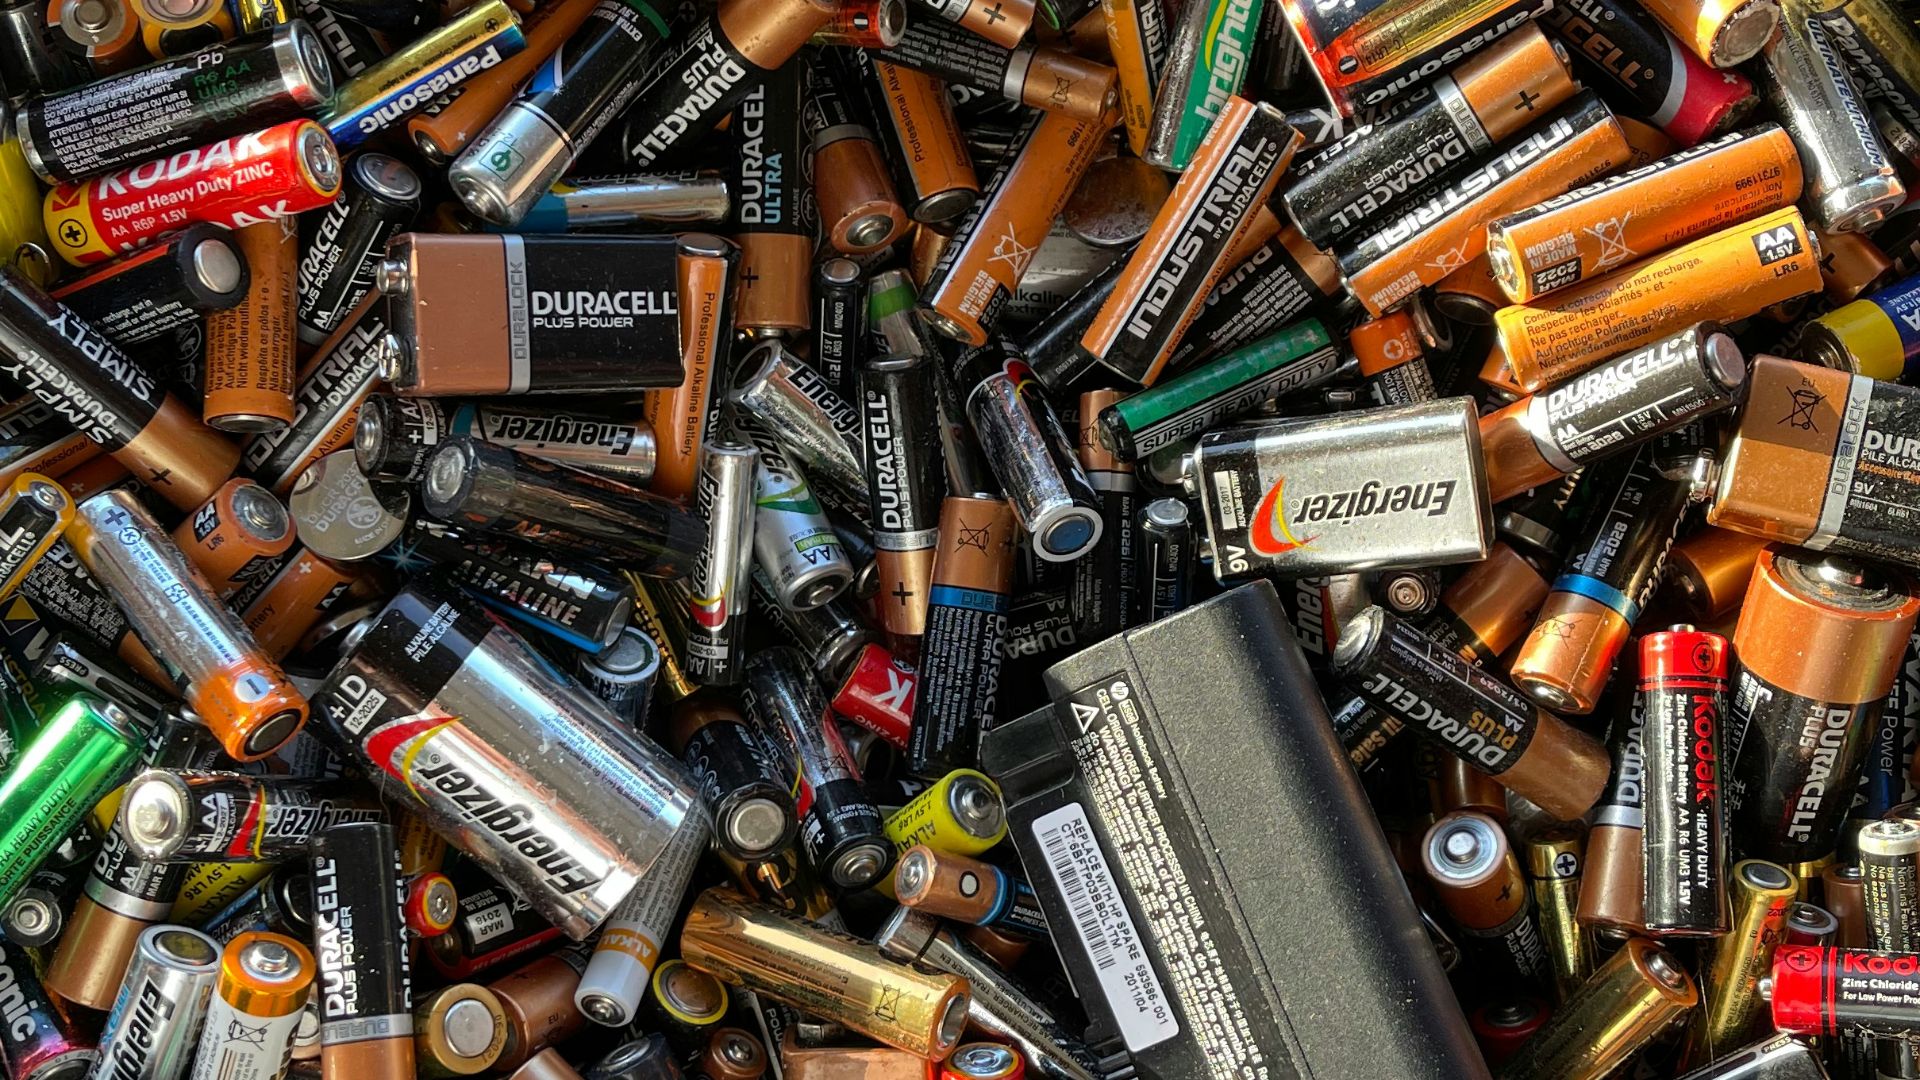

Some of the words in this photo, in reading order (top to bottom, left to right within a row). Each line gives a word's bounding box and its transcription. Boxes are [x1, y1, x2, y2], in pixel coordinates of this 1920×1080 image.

[197, 51, 224, 69] Pb
[682, 42, 728, 90] PLUS
[1366, 0, 1555, 105] Panasonic
[358, 43, 504, 134] Panasonic
[1805, 18, 1850, 98] ULTIMATE
[1841, 98, 1884, 166] LITHIUM
[63, 111, 86, 121] MAKE
[112, 102, 151, 120] EXPLOSER
[631, 57, 747, 162] DURACELL
[892, 80, 926, 163] Professional
[740, 84, 765, 225] DURACEL
[1415, 127, 1456, 159] PLUS
[98, 128, 277, 200] KODAK
[1362, 152, 1416, 191] POWER
[1735, 166, 1780, 190] 97311999
[102, 202, 149, 223] Super
[147, 186, 197, 210] Heavy
[196, 173, 234, 200] Duty
[234, 161, 275, 185] ZINC
[764, 152, 783, 224] ULTRA
[1217, 148, 1278, 232] DURACELL
[1330, 138, 1468, 230] DURACELL
[1357, 117, 1576, 251] INDUSTRIAL
[110, 225, 130, 239] AA
[132, 217, 156, 233] R6P
[161, 208, 189, 225] 1.5V
[1127, 136, 1268, 340] INDUSTRIAL
[1212, 229, 1223, 240] BY
[1758, 226, 1795, 251] AA
[298, 201, 350, 295] URACELL
[1524, 232, 1576, 259] BELGIUM
[1766, 242, 1794, 261] 1.5V
[300, 289, 320, 319] PLUS
[316, 244, 343, 288] POWER
[1536, 260, 1579, 284] 2022
[1538, 273, 1576, 293] MAR
[1774, 261, 1799, 277] LR6
[531, 290, 678, 316] DURACELL
[958, 270, 985, 314] BELGIUM
[979, 276, 997, 304] MADE
[1523, 304, 1565, 325] Connect
[1634, 273, 1651, 286] not
[1653, 257, 1703, 280] recharge.
[313, 309, 331, 329] AA
[533, 316, 574, 328] PLUS
[579, 316, 634, 328] POWER
[696, 292, 716, 365] Professional
[967, 304, 979, 318] IN
[1526, 312, 1582, 336] Respecter
[1599, 289, 1643, 315] polarités
[1549, 331, 1568, 346] pas
[1569, 309, 1627, 338] recharger.
[1596, 315, 1640, 337] Polarität
[47, 310, 155, 401] SIMPLY
[236, 353, 249, 389] Nicht
[1539, 354, 1567, 370] Nicht
[30, 353, 116, 429] DURACELL
[689, 366, 706, 417] Alkaline
[1548, 342, 1678, 414] DURACELL
[1802, 377, 1815, 387] EU
[0, 362, 105, 444] SIMPLY
[1142, 416, 1204, 454] SUPER
[1207, 384, 1273, 429] HEAVY
[1277, 358, 1332, 393] DUTY
[1550, 403, 1588, 425] PLUS
[1588, 380, 1638, 409] POWER
[492, 415, 638, 457] Energizer
[681, 418, 700, 458] Battery
[1557, 423, 1580, 442] AA
[1570, 446, 1589, 460] MAR
[1590, 431, 1625, 451] 2028
[869, 394, 901, 529] DURACELL
[894, 436, 909, 482] POWER
[1860, 450, 1885, 463] PILE
[902, 484, 915, 529] PLUS
[1222, 485, 1233, 516] 03-2017
[1291, 479, 1458, 526] Energizer
[1854, 482, 1875, 495] 9V
[194, 501, 216, 529] AA
[207, 533, 225, 551] LR6
[802, 545, 832, 565] AA
[1604, 520, 1628, 555] 2028
[1226, 545, 1249, 572] 9V
[405, 614, 437, 656] ALKALINE
[431, 610, 461, 644] ALCALINE
[981, 614, 996, 660] ULTRA
[59, 656, 88, 676] PRESS
[973, 664, 990, 719] POWER
[1676, 693, 1688, 718] Zinc
[350, 695, 381, 730] 12-2025
[854, 714, 892, 737] ZINC
[1370, 673, 1508, 767] DURACELL
[1468, 710, 1519, 750] PLUS
[1503, 714, 1525, 732] AA
[1800, 705, 1827, 748] PLUS
[1677, 719, 1688, 763] Chloride
[1693, 694, 1718, 804] Kodak
[1880, 715, 1898, 777] Power
[1130, 723, 1155, 768] Notebook
[1148, 767, 1168, 799] Battery
[1787, 709, 1851, 838] DURACELL
[1677, 763, 1690, 804] Battery
[25, 797, 77, 857] PUISSANCE
[201, 793, 217, 828] AA
[1096, 688, 1112, 715] CELL
[1107, 713, 1128, 748] ORIGIN
[1121, 747, 1142, 781] KOREA
[1133, 778, 1161, 828] FURTHER
[1153, 824, 1187, 888] PROCESSED
[1184, 895, 1205, 929] CHINA
[1678, 808, 1689, 825] AA
[12, 815, 42, 850] HEAVY
[416, 761, 601, 896] Energizer
[1678, 830, 1690, 844] R6
[1697, 812, 1709, 850] HEAVY
[105, 840, 129, 881] PLUS
[120, 866, 140, 890] AA
[1106, 767, 1122, 796] short
[1116, 797, 1141, 842] external
[1174, 931, 1197, 976] dispose
[1678, 849, 1690, 875] UM3
[1697, 851, 1709, 888] DUTY
[1071, 818, 1102, 872] REPLACE
[1095, 872, 1115, 899] WITH
[1108, 903, 1122, 918] HP
[1117, 921, 1140, 960] SPARE
[1099, 725, 1133, 791] WARNING!
[1133, 803, 1154, 845] reduce
[1179, 913, 1199, 952] burns,
[1210, 991, 1246, 1065] disassemble.
[1678, 879, 1691, 905] 1.5V
[338, 906, 357, 965] POWER
[474, 909, 502, 925] 2018
[479, 922, 504, 936] MAR
[315, 858, 345, 1018] DURACELL
[341, 968, 359, 1014] PLUS
[1124, 973, 1148, 1012] 2011/04
[1842, 978, 1868, 989] Zinc
[1869, 979, 1919, 991] Chloride
[1843, 992, 1858, 1000] For
[1859, 992, 1875, 1001] Low
[1877, 994, 1903, 1004] Power
[1764, 1037, 1792, 1052] PRESS
